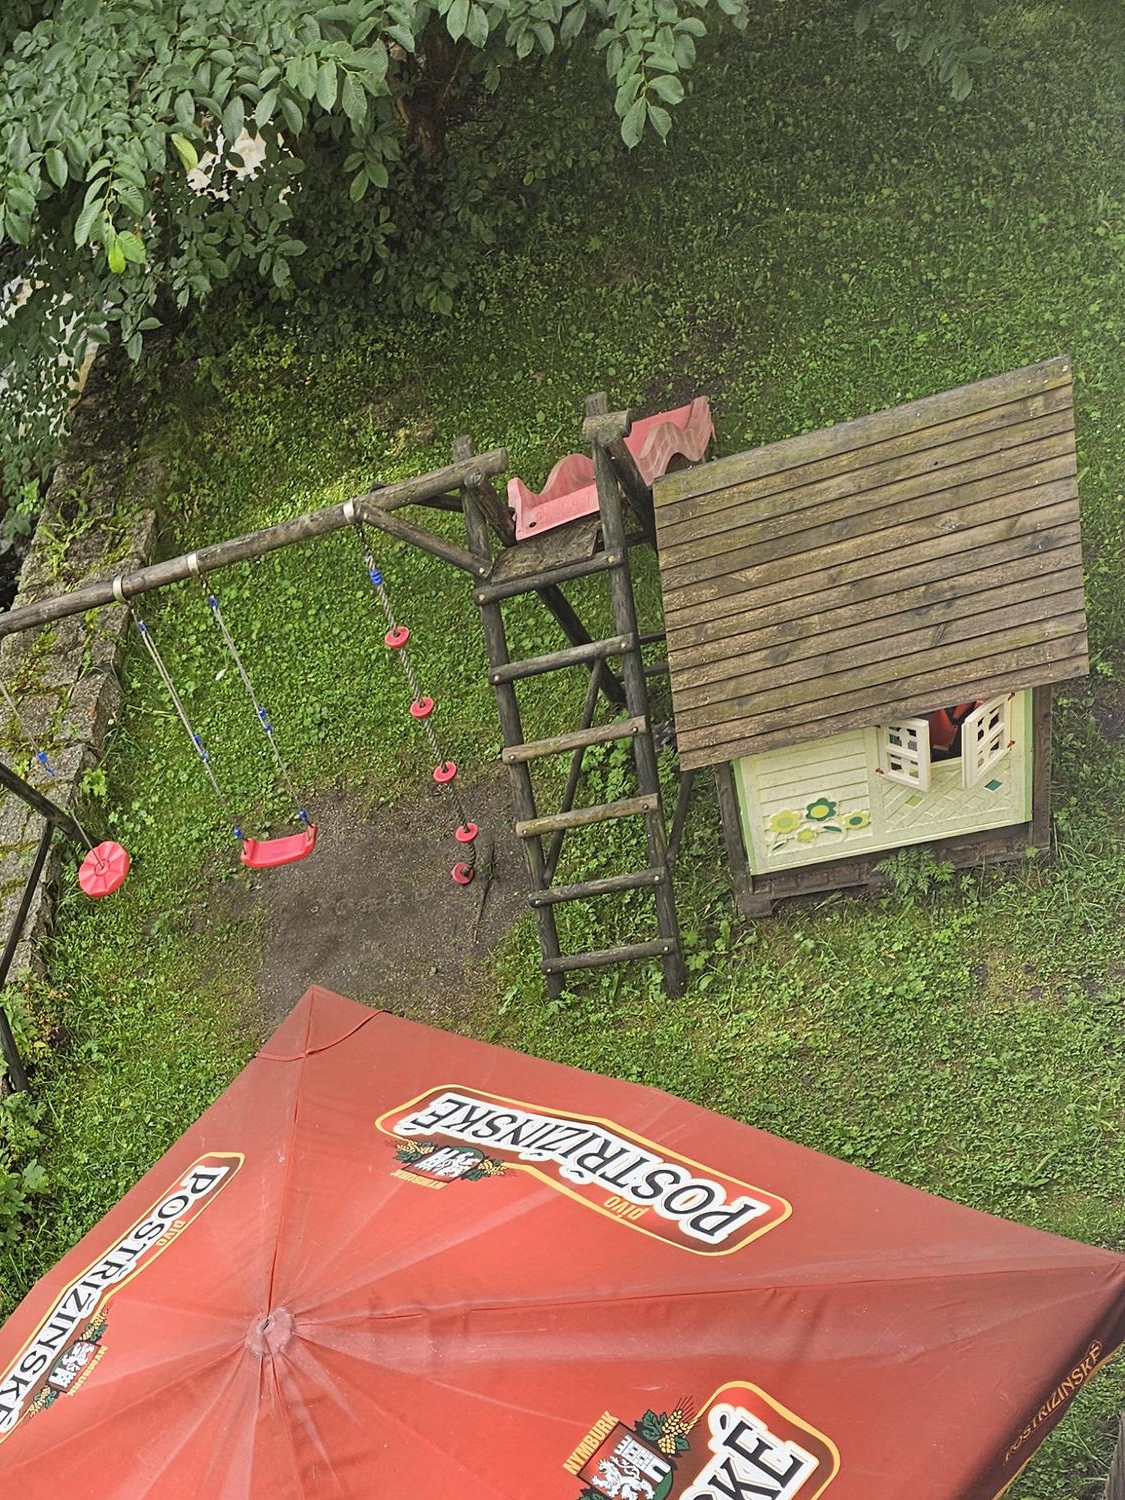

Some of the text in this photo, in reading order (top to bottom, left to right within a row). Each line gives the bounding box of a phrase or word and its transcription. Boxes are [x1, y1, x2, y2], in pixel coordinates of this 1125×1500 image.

[403, 1097, 757, 1237] POSTŘIŽINSKÉ
[155, 1219, 186, 1247] pivo
[603, 1195, 650, 1220] pivo
[67, 1345, 108, 1397] NYMBURK
[562, 1410, 620, 1477] NYMBURK
